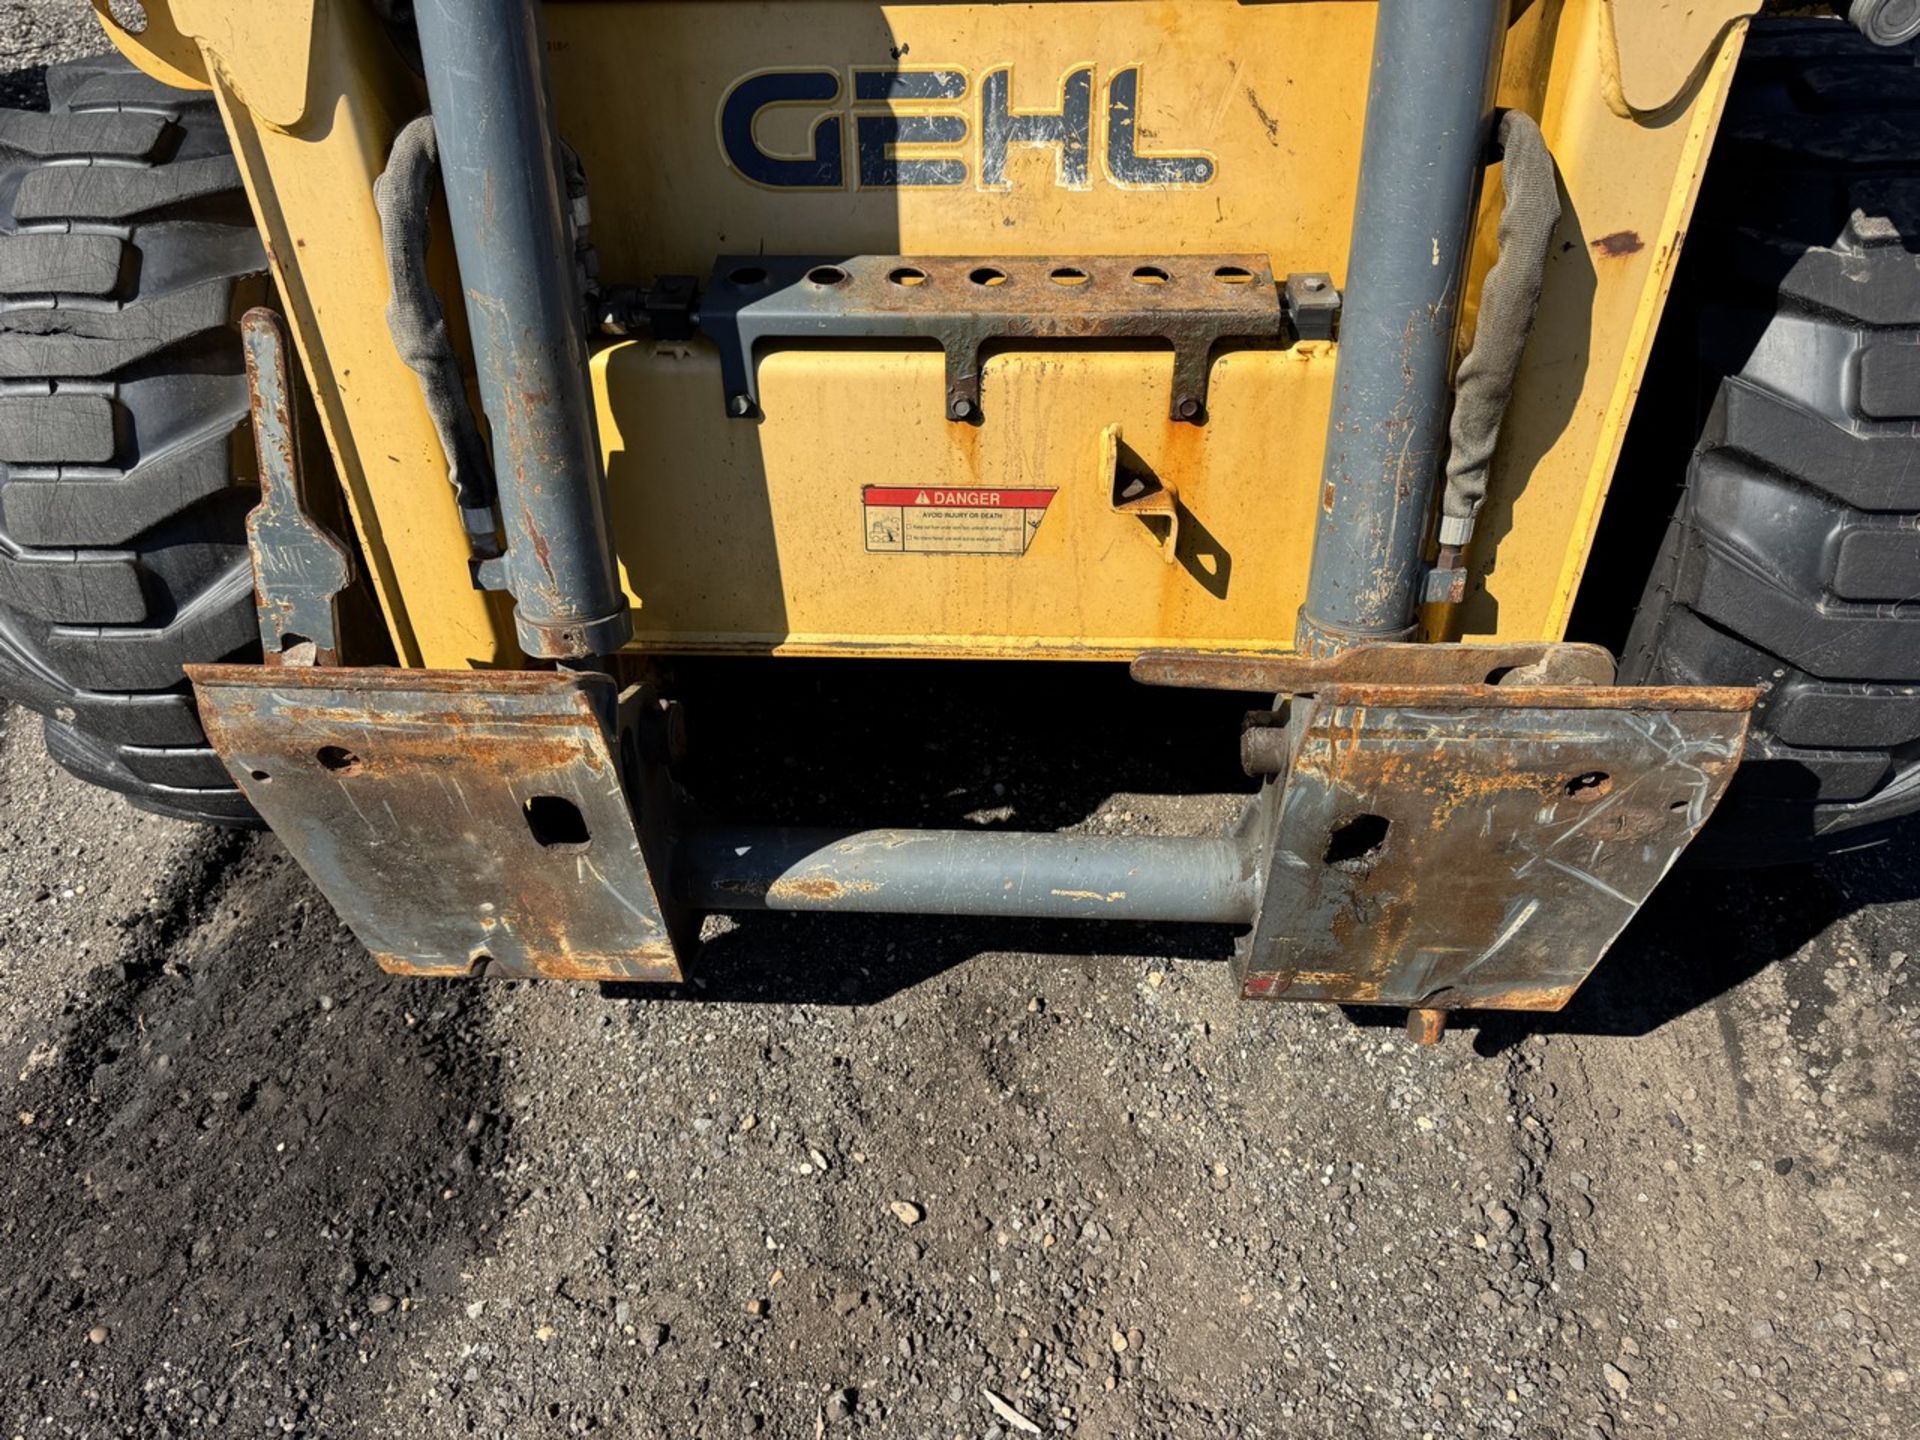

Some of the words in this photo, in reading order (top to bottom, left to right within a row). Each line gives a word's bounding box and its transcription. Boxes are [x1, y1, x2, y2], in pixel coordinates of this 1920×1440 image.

[718, 65, 1217, 190] GEHL
[934, 491, 1000, 505] DANGER
[922, 511, 943, 519] AVOID
[980, 512, 1003, 520] DEATH
